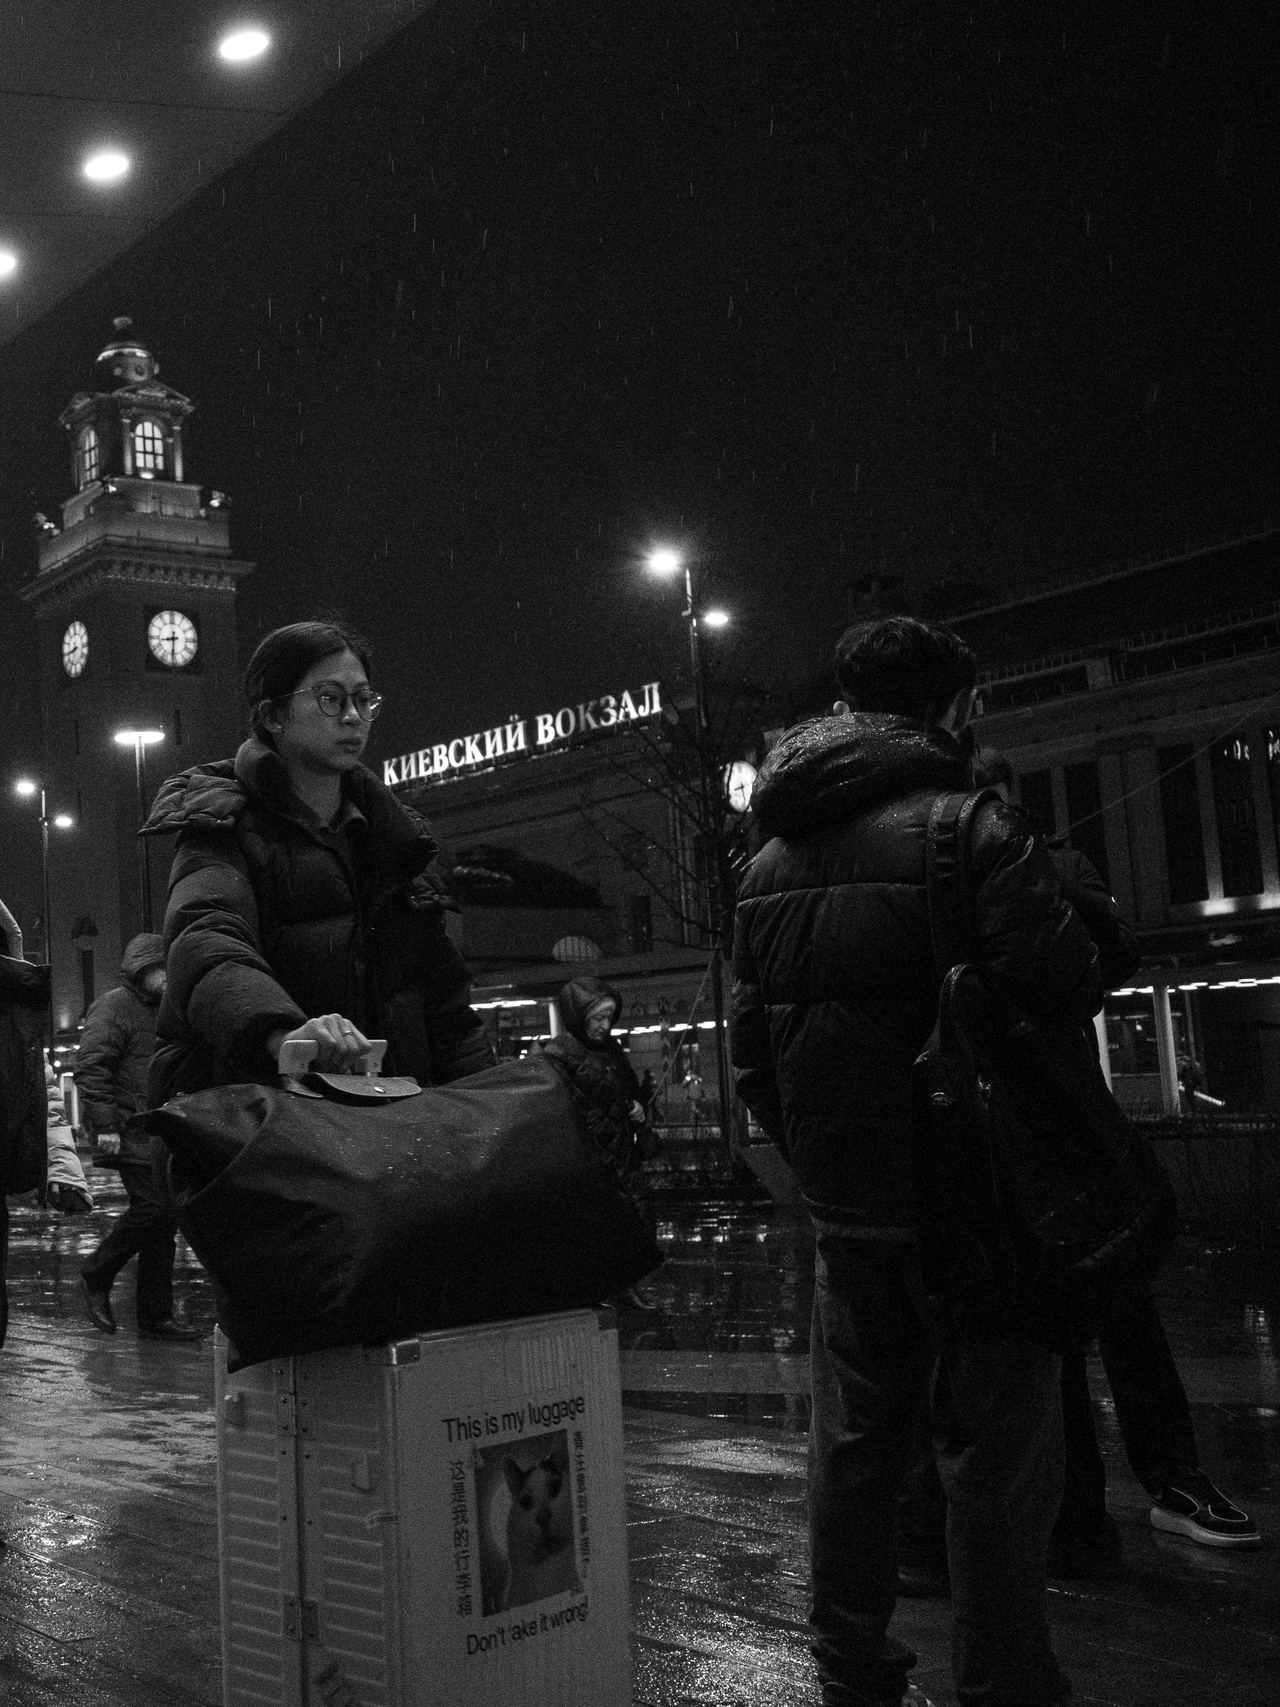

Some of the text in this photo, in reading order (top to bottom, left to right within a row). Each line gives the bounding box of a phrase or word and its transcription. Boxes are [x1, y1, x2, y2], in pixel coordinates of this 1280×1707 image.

[383, 682, 663, 786] КИЕВСКИЙ ВОКЗАЛ
[441, 1396, 585, 1443] This is my luggage
[466, 1626, 507, 1655] Don't
